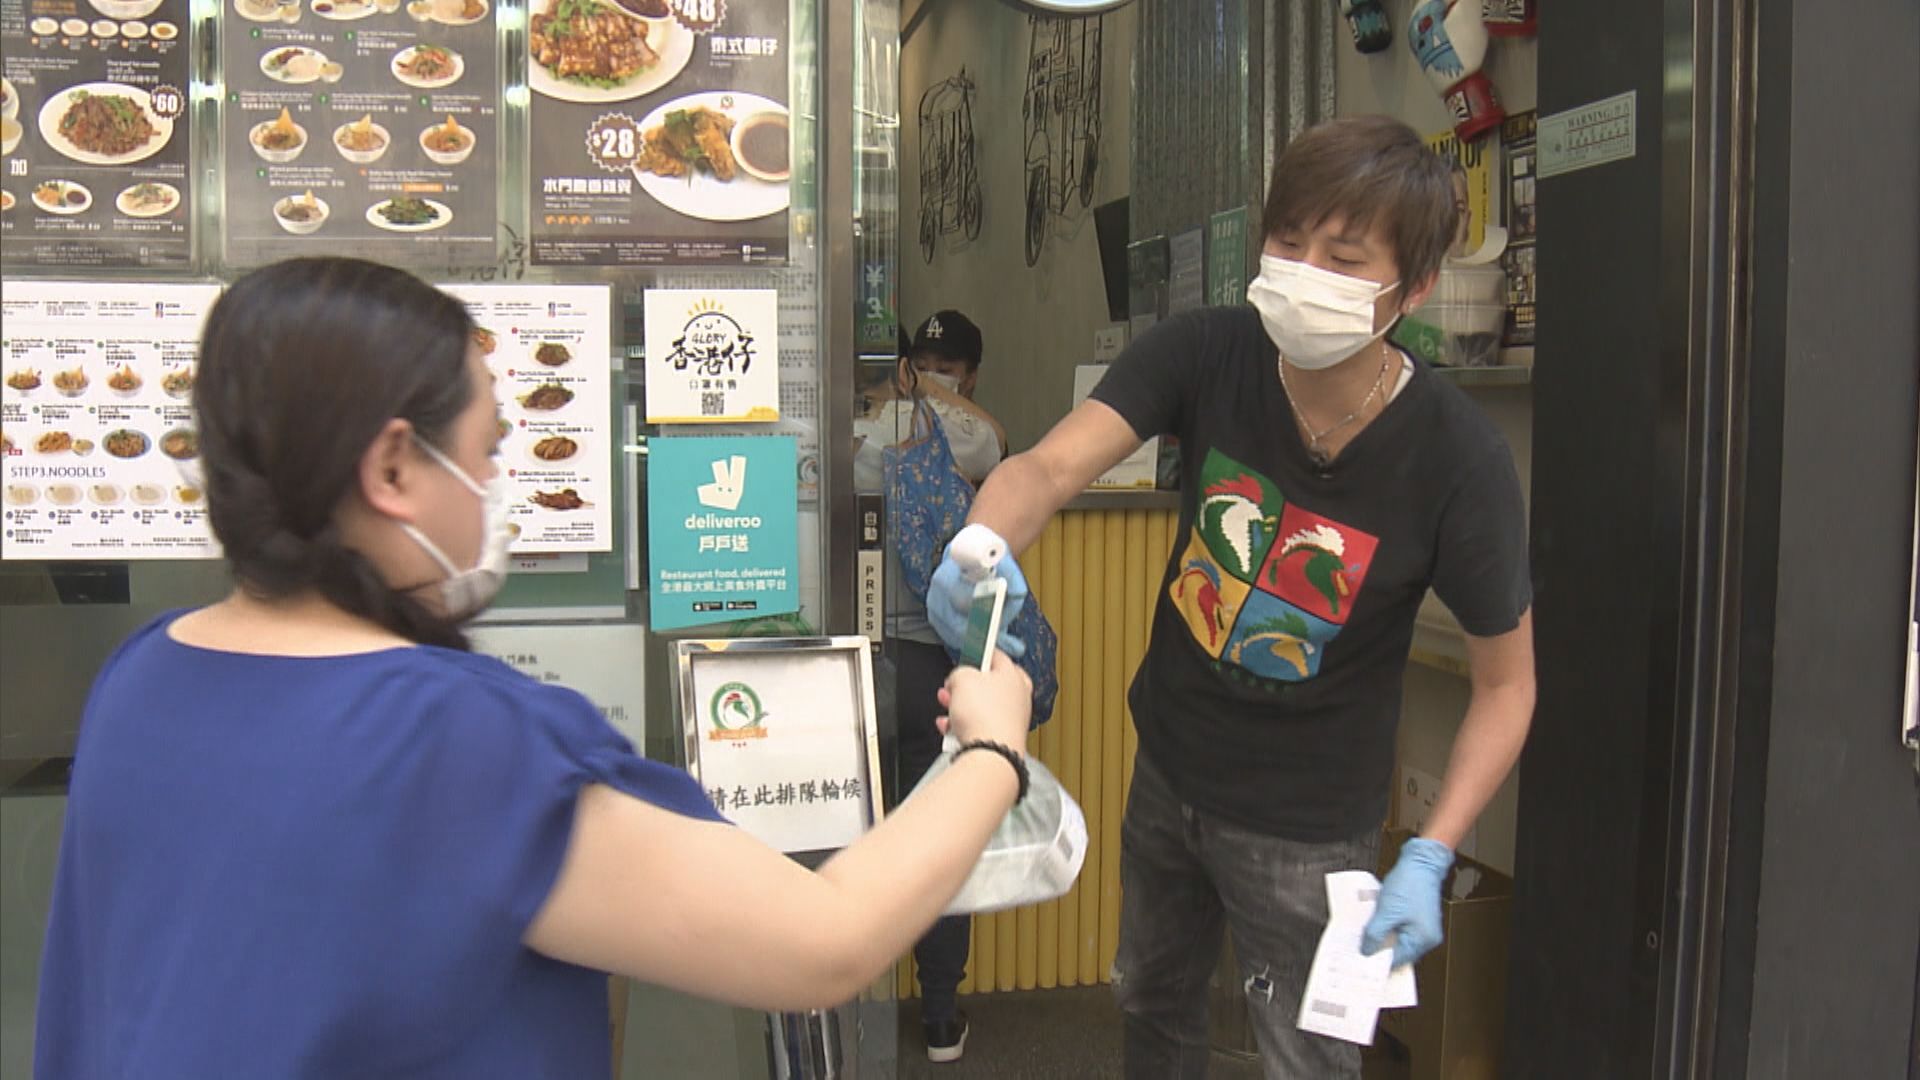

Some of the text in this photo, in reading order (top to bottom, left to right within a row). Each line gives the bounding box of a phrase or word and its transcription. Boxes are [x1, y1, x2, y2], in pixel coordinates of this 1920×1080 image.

[593, 128, 635, 158] $28
[926, 316, 943, 338] LA
[692, 332, 726, 345] GLORY
[665, 333, 757, 375] 香港仔
[685, 512, 761, 529] deliveroo
[660, 569, 713, 580] Restaurant
[740, 567, 786, 578] delivered
[866, 565, 875, 631] PRESS
